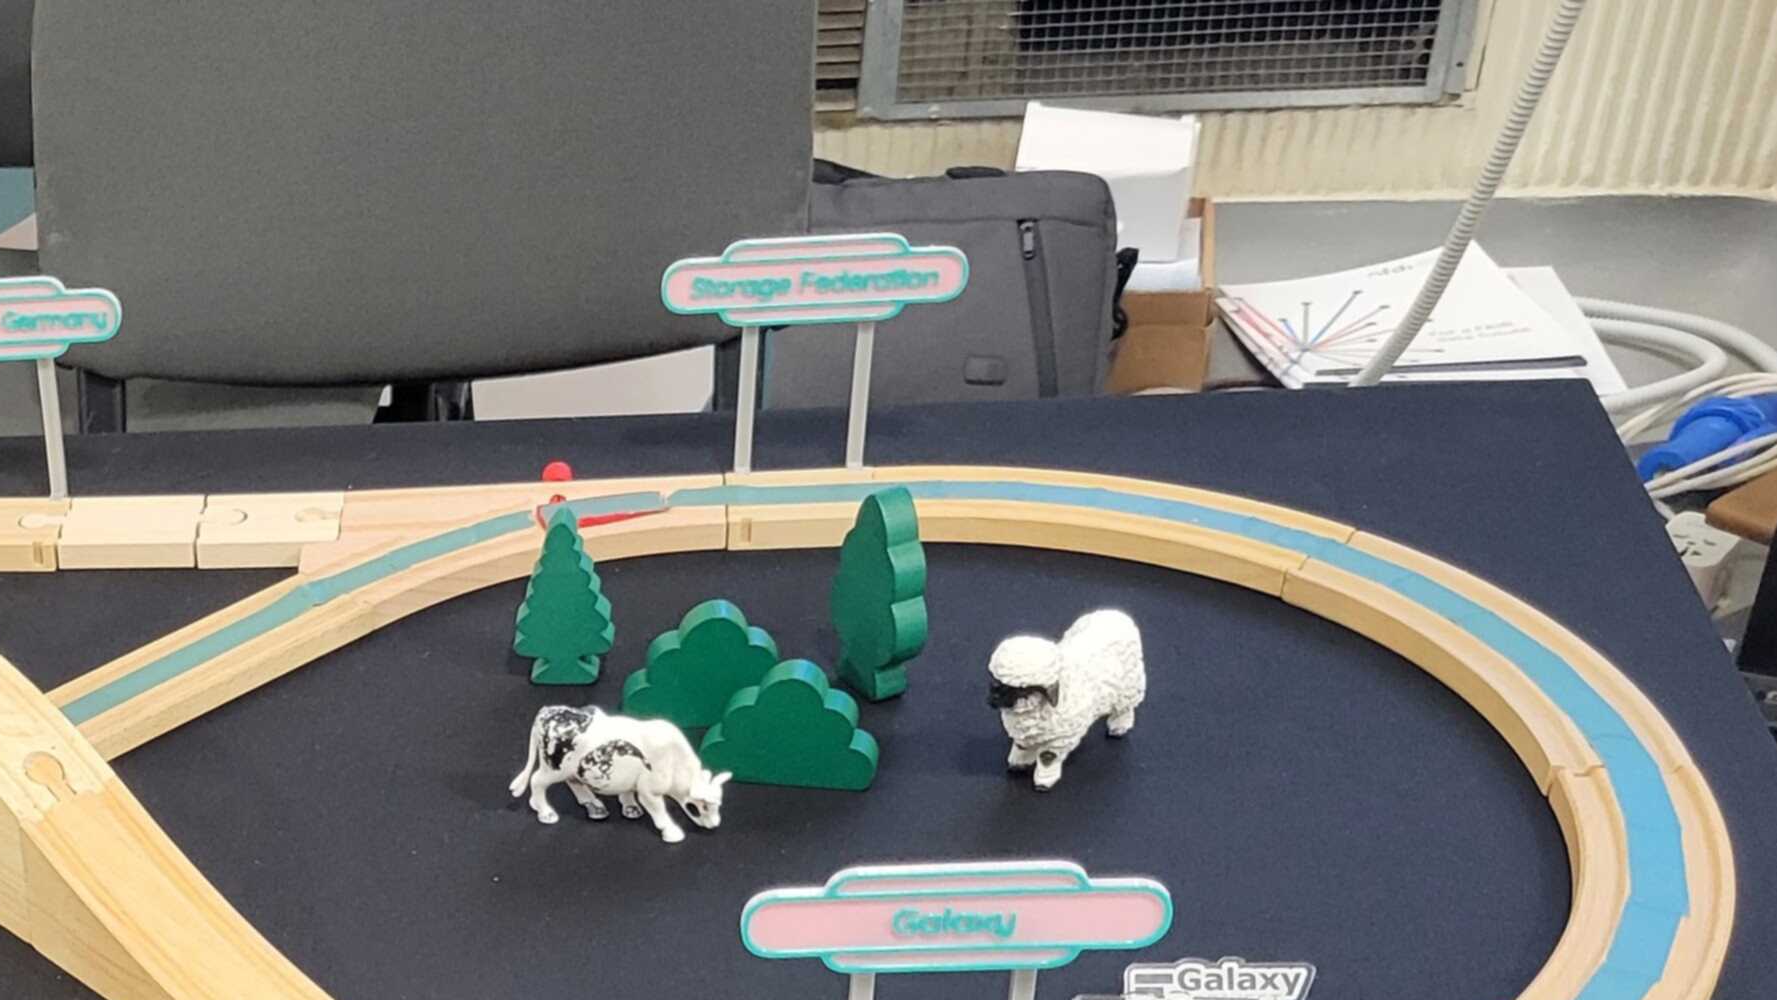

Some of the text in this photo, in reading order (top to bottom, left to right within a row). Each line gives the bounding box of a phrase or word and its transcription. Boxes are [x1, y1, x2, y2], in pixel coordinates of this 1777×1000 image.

[1, 310, 109, 331] Germany
[890, 907, 1018, 940] Galaxy
[1177, 967, 1302, 997] Galaxy
